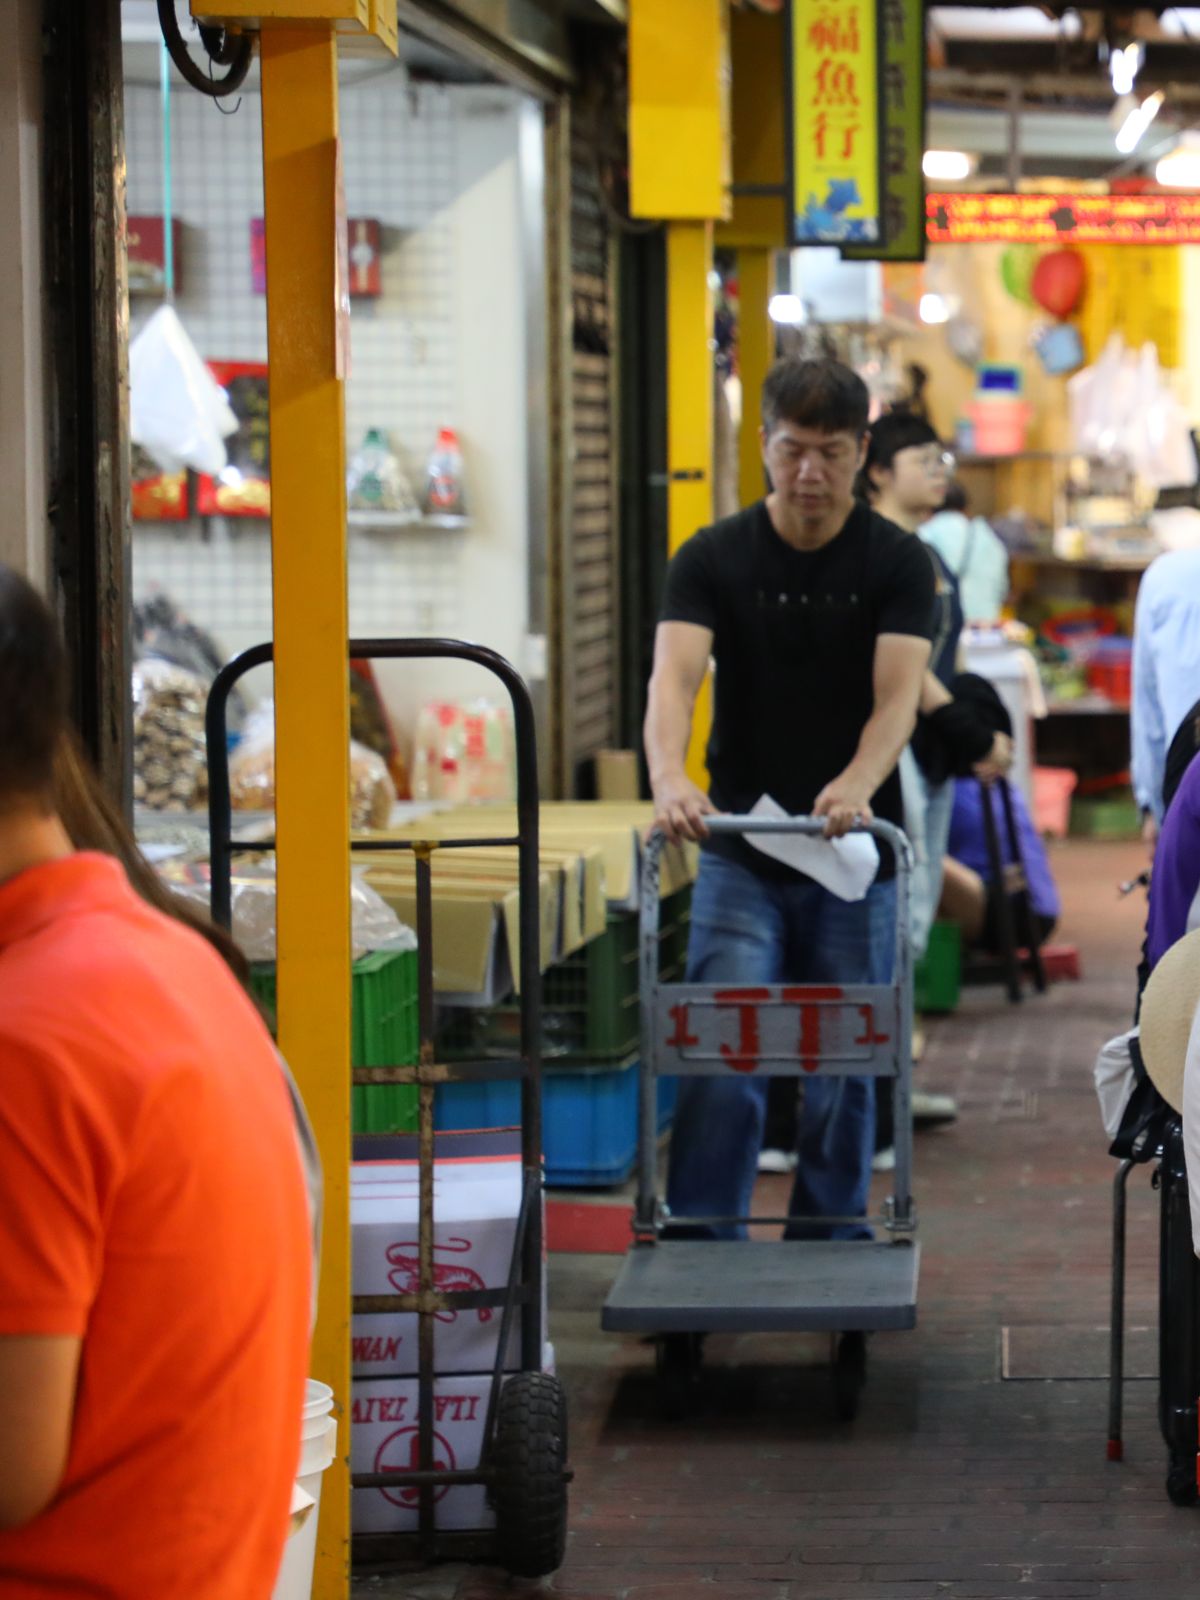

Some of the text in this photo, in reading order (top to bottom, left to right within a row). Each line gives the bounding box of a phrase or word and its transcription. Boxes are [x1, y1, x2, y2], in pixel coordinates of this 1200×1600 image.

[806, 0, 863, 160] 福魚行
[414, 1396, 480, 1421] ILA
